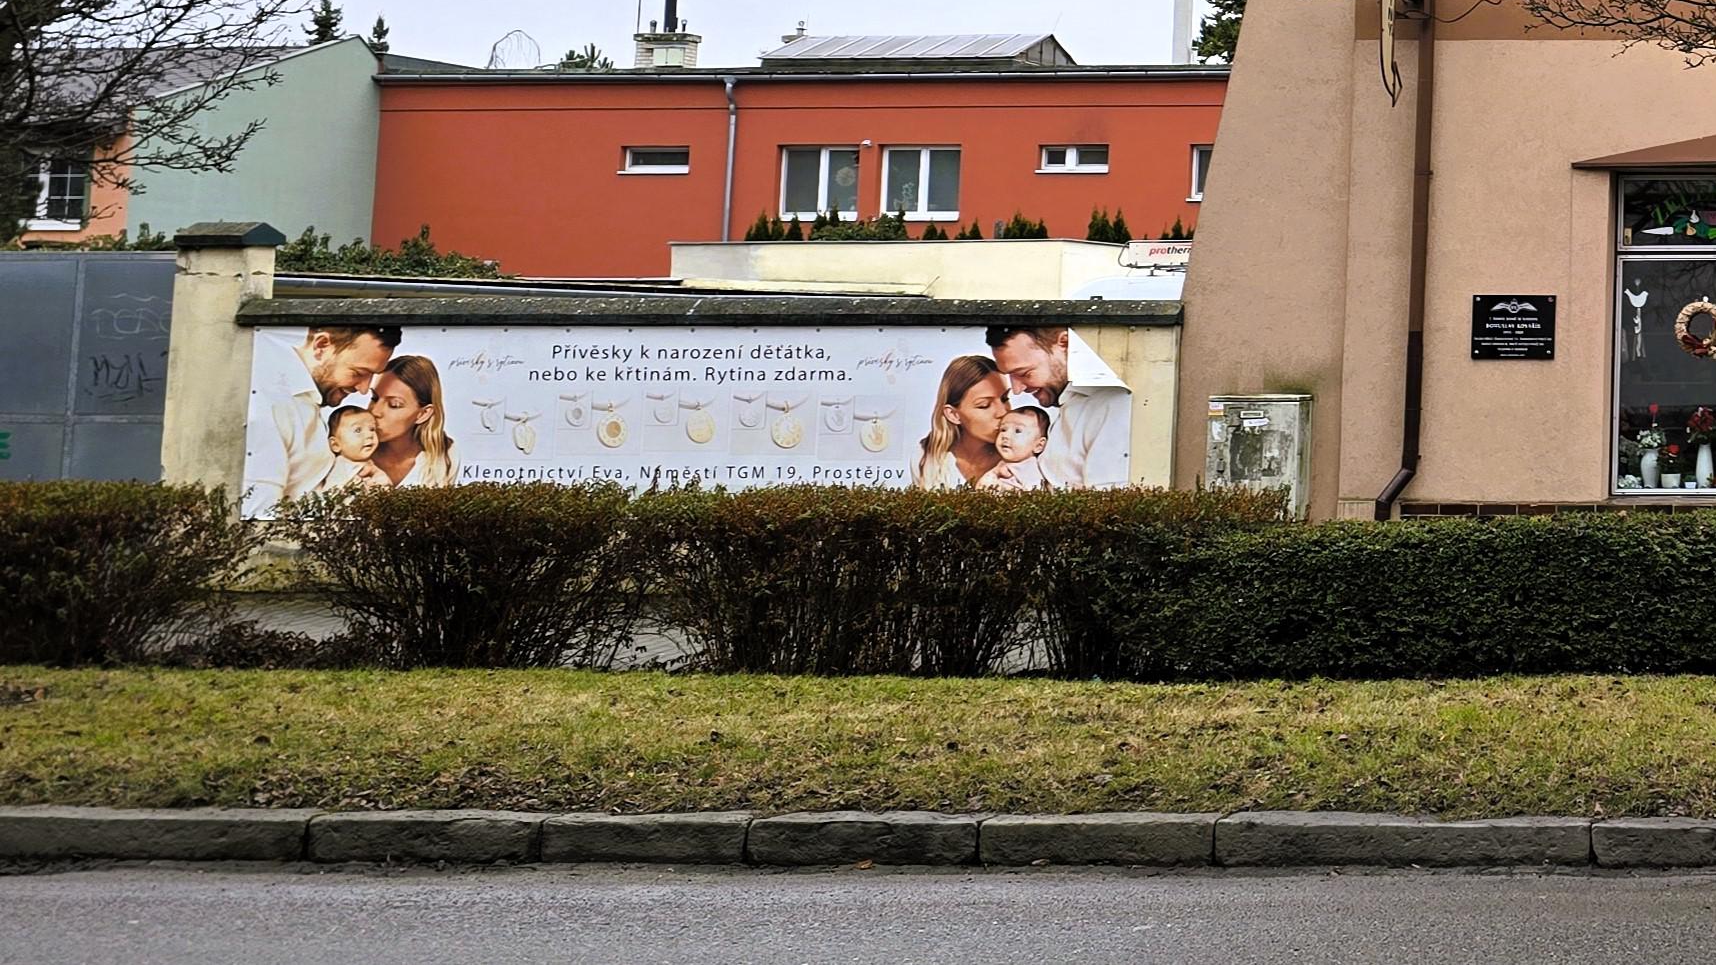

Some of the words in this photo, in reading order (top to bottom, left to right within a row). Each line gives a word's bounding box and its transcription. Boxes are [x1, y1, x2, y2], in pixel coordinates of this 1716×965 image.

[551, 344, 633, 364] Přívěsky
[640, 344, 650, 359] k
[657, 344, 744, 360] narození
[750, 344, 832, 362] děťátka,
[528, 366, 578, 381] nebo
[585, 366, 607, 381] ke
[614, 366, 697, 381] křtinám.
[705, 366, 767, 385] Rytina
[774, 366, 853, 381] zdarma.
[463, 465, 584, 479] Klenotnictví
[592, 465, 630, 481] Eva,
[640, 465, 718, 479] Náměstí
[726, 465, 765, 479] TGM
[776, 465, 802, 481] 19,
[812, 465, 905, 484] Prostějov
